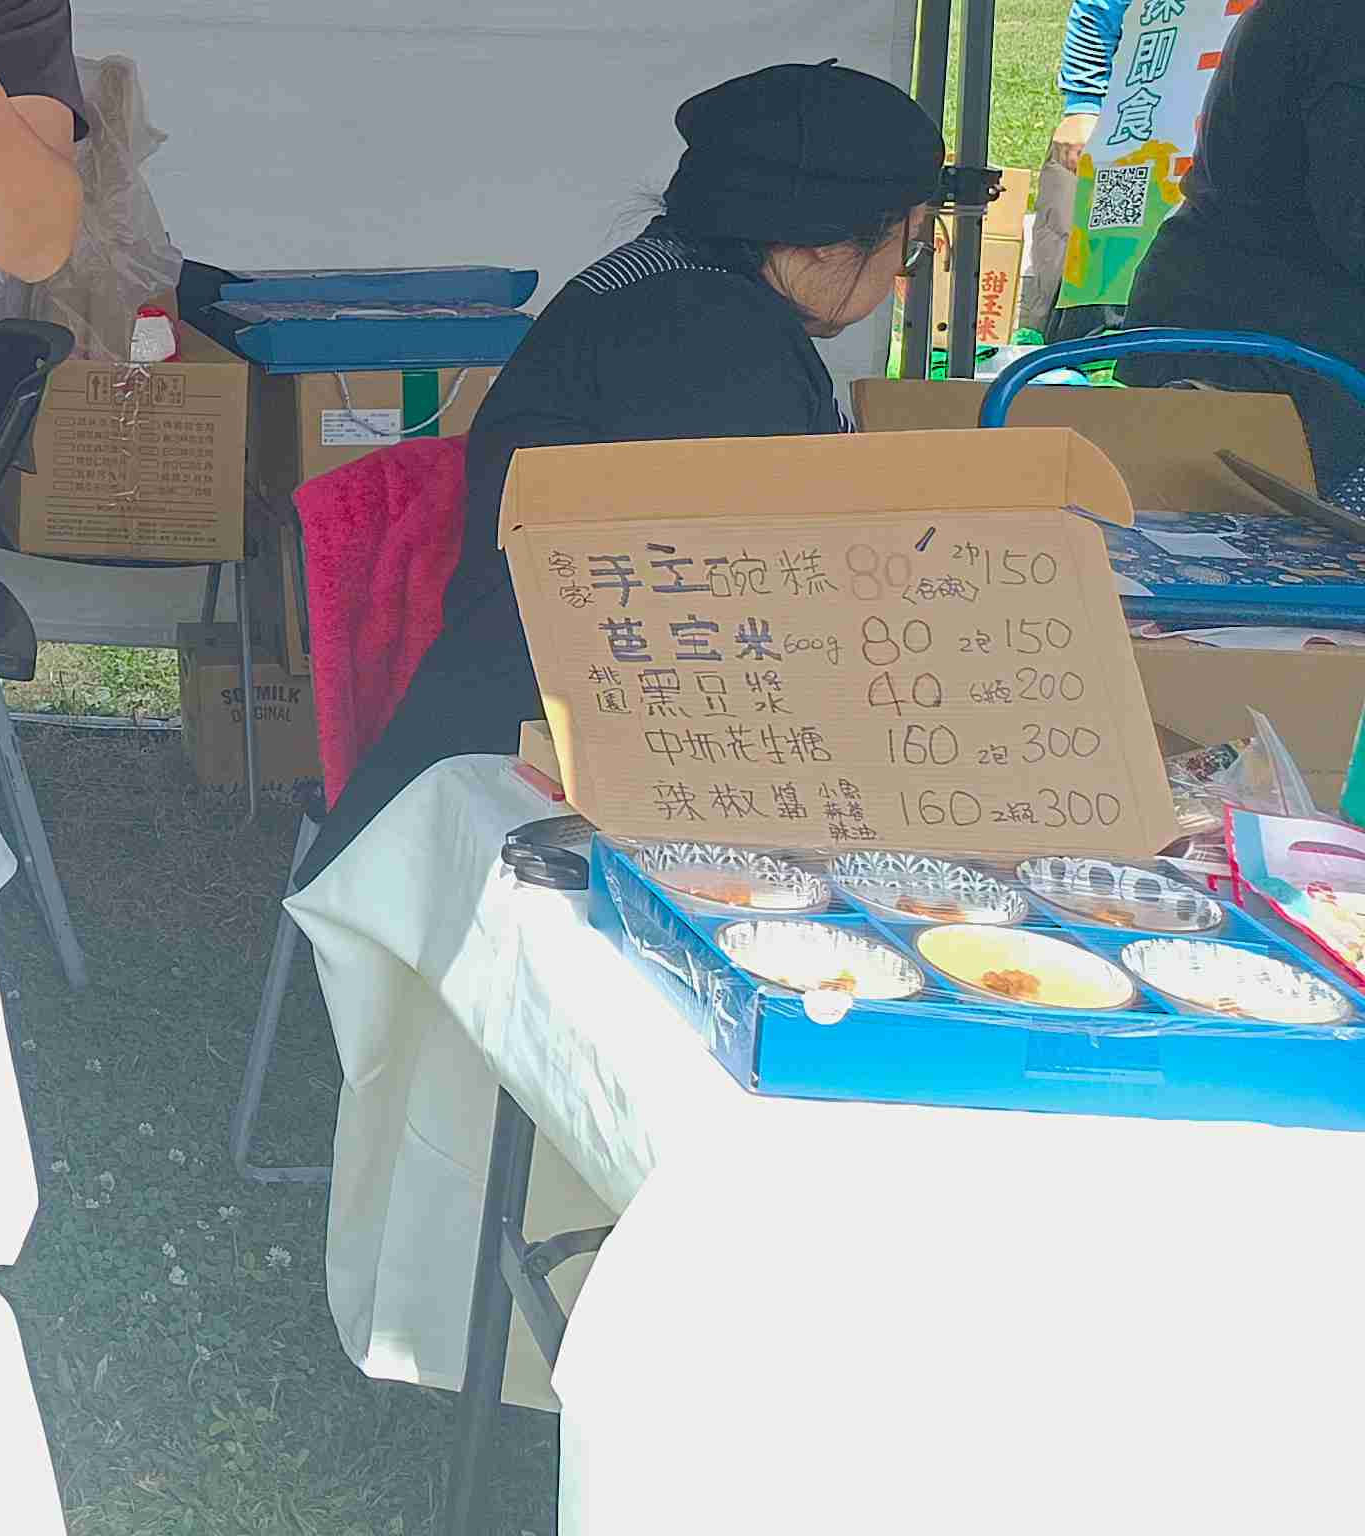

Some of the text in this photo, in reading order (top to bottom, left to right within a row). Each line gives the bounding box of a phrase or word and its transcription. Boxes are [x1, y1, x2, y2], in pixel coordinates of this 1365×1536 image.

[977, 270, 1009, 342] 甜玉米
[844, 541, 913, 602] 80
[982, 548, 1057, 586] 150
[861, 615, 933, 667] 80
[1003, 617, 1072, 656] 150
[868, 670, 944, 716] 40
[1014, 667, 1085, 702] 200
[888, 723, 960, 766] 160
[1021, 723, 1101, 764] 300
[900, 789, 982, 827] 160
[1038, 786, 1122, 828] 300
